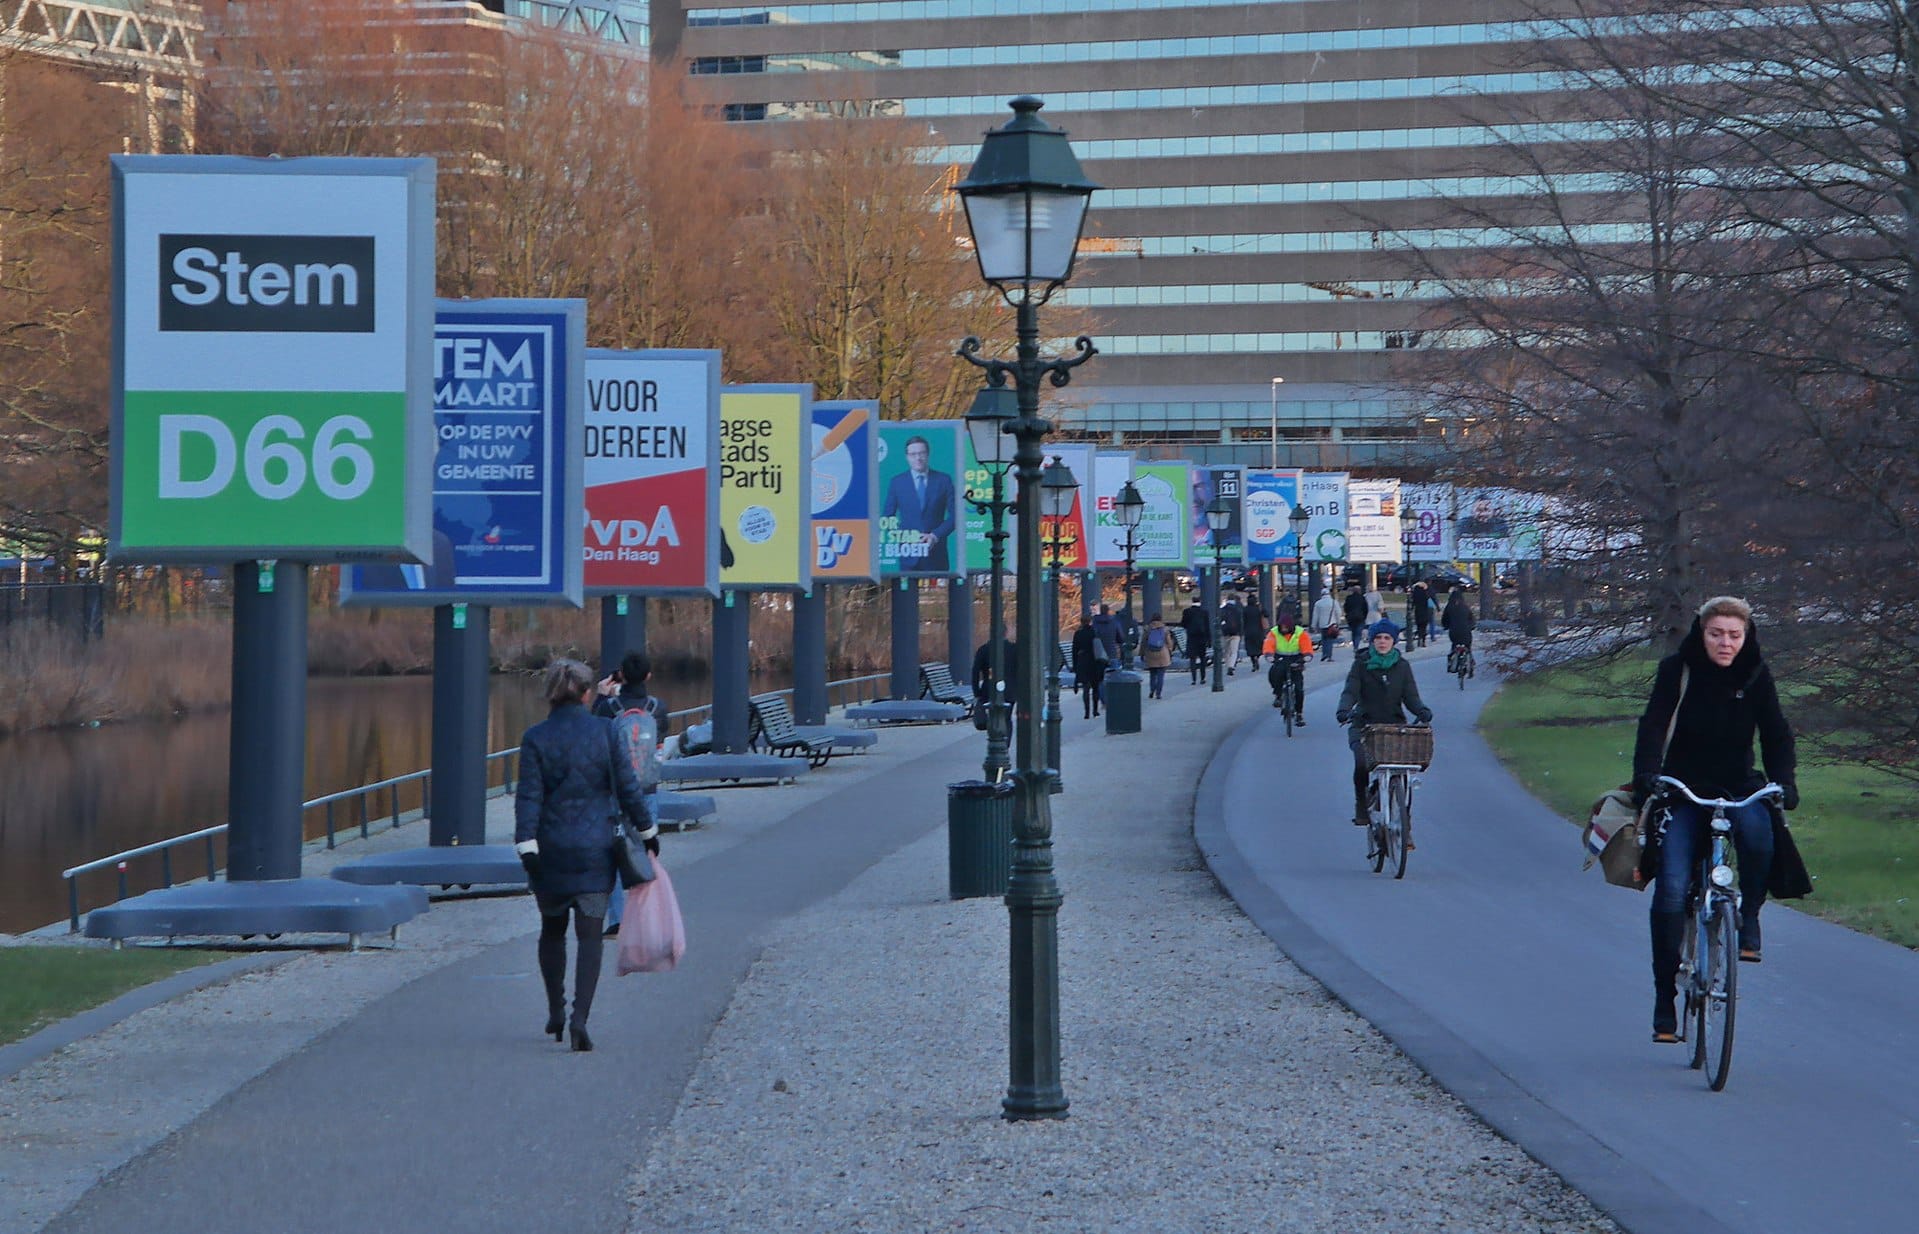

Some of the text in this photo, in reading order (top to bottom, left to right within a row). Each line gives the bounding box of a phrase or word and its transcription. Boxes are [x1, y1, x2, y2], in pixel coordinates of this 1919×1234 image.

[170, 246, 359, 306] Stem
[434, 338, 534, 379] TEM
[587, 379, 657, 412] VOOR
[440, 425, 534, 440] OP DE PVV
[720, 419, 772, 443] agse
[584, 425, 686, 458] DEREEN
[158, 413, 375, 501] D66
[459, 445, 515, 460] IN UW
[438, 465, 535, 480] GEMEENTE
[720, 465, 782, 494] Partij
[965, 470, 989, 486] ep
[1222, 483, 1237, 495] 11
[1312, 482, 1339, 492] Haag
[1330, 501, 1340, 516] B
[584, 547, 660, 565] Den Haag
[815, 526, 854, 569] VVD
[885, 543, 930, 557] BLOEIT
